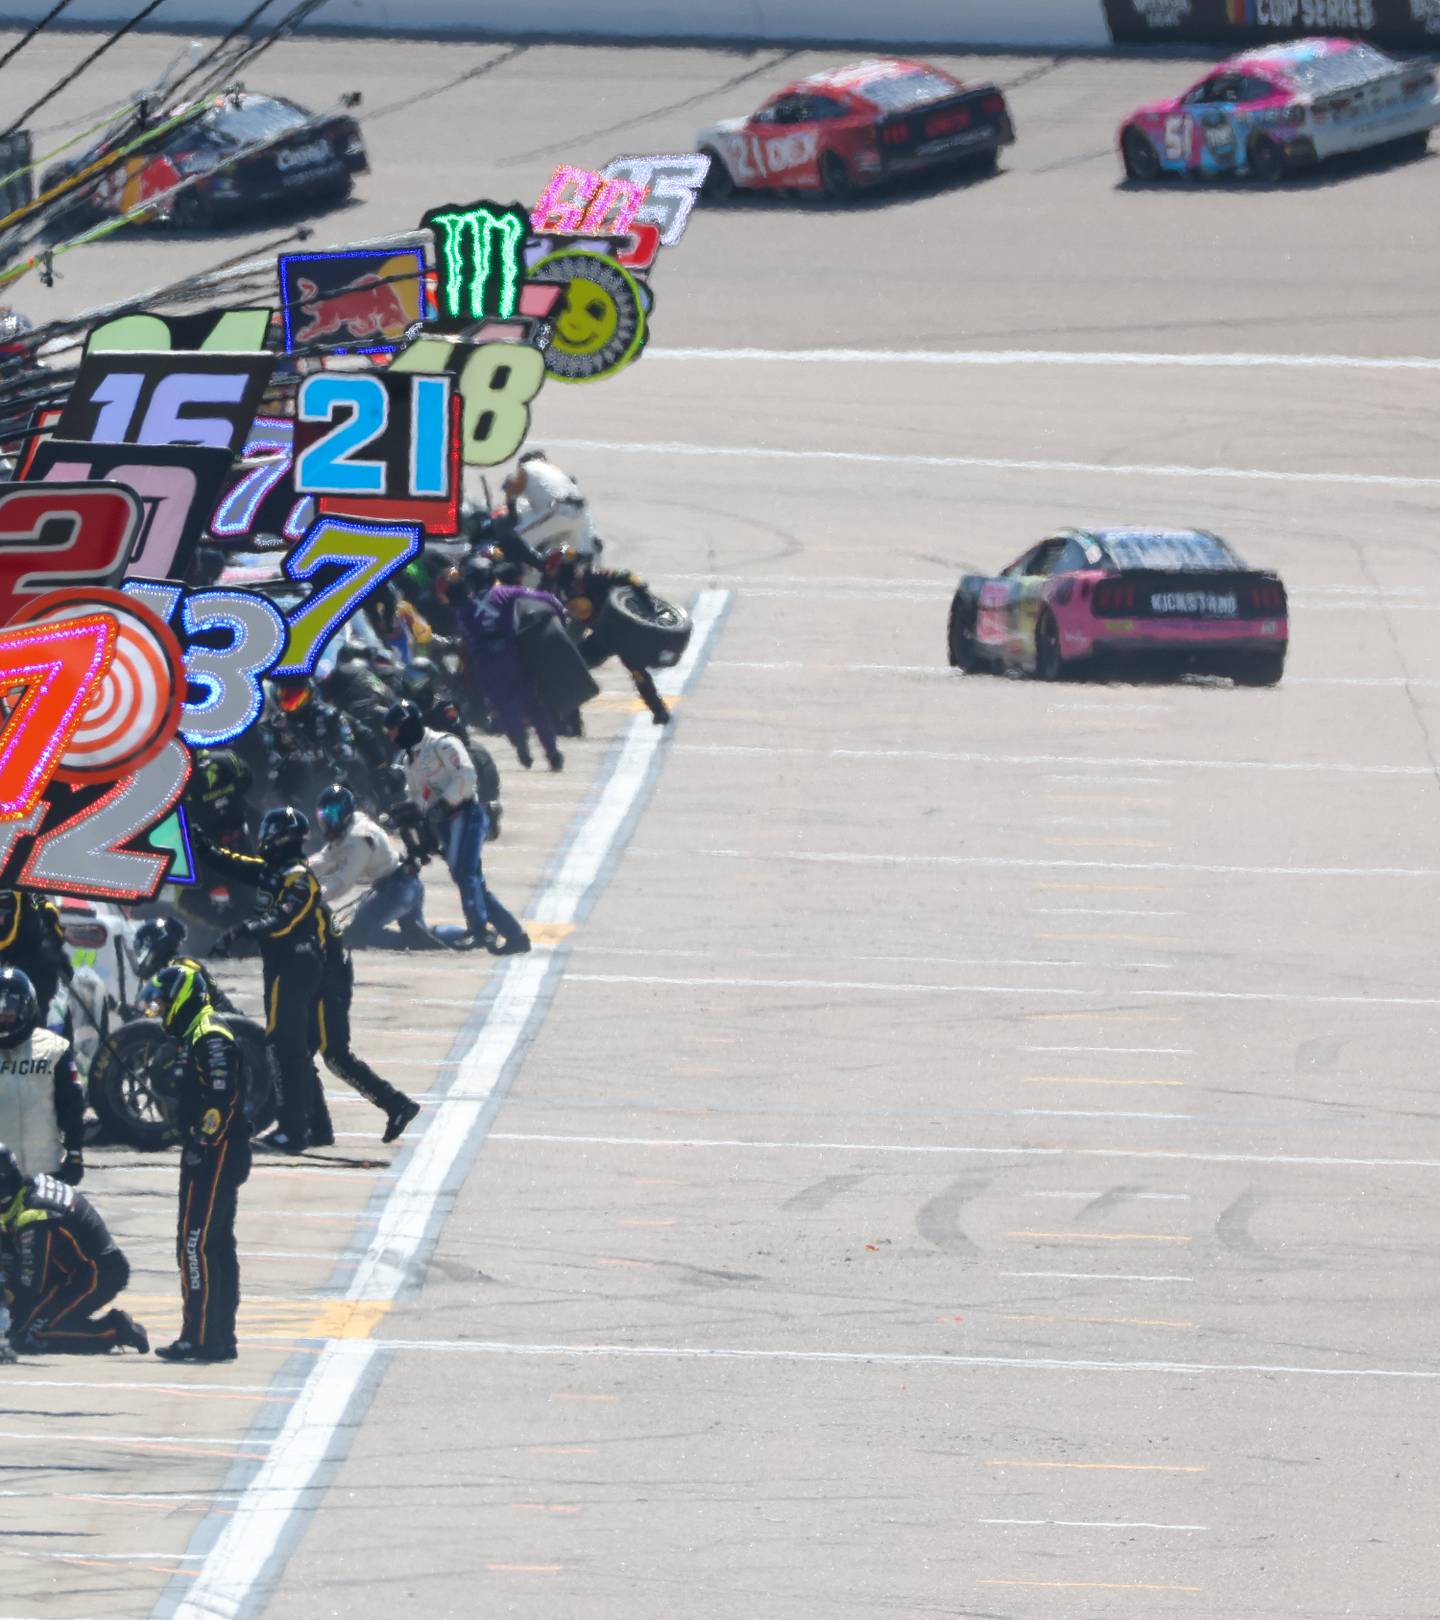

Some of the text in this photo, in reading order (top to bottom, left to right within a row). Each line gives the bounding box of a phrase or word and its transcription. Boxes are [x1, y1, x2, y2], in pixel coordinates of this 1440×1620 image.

[294, 374, 451, 498] 21
[270, 517, 424, 678] 7
[185, 1227, 202, 1290] DURACELL
